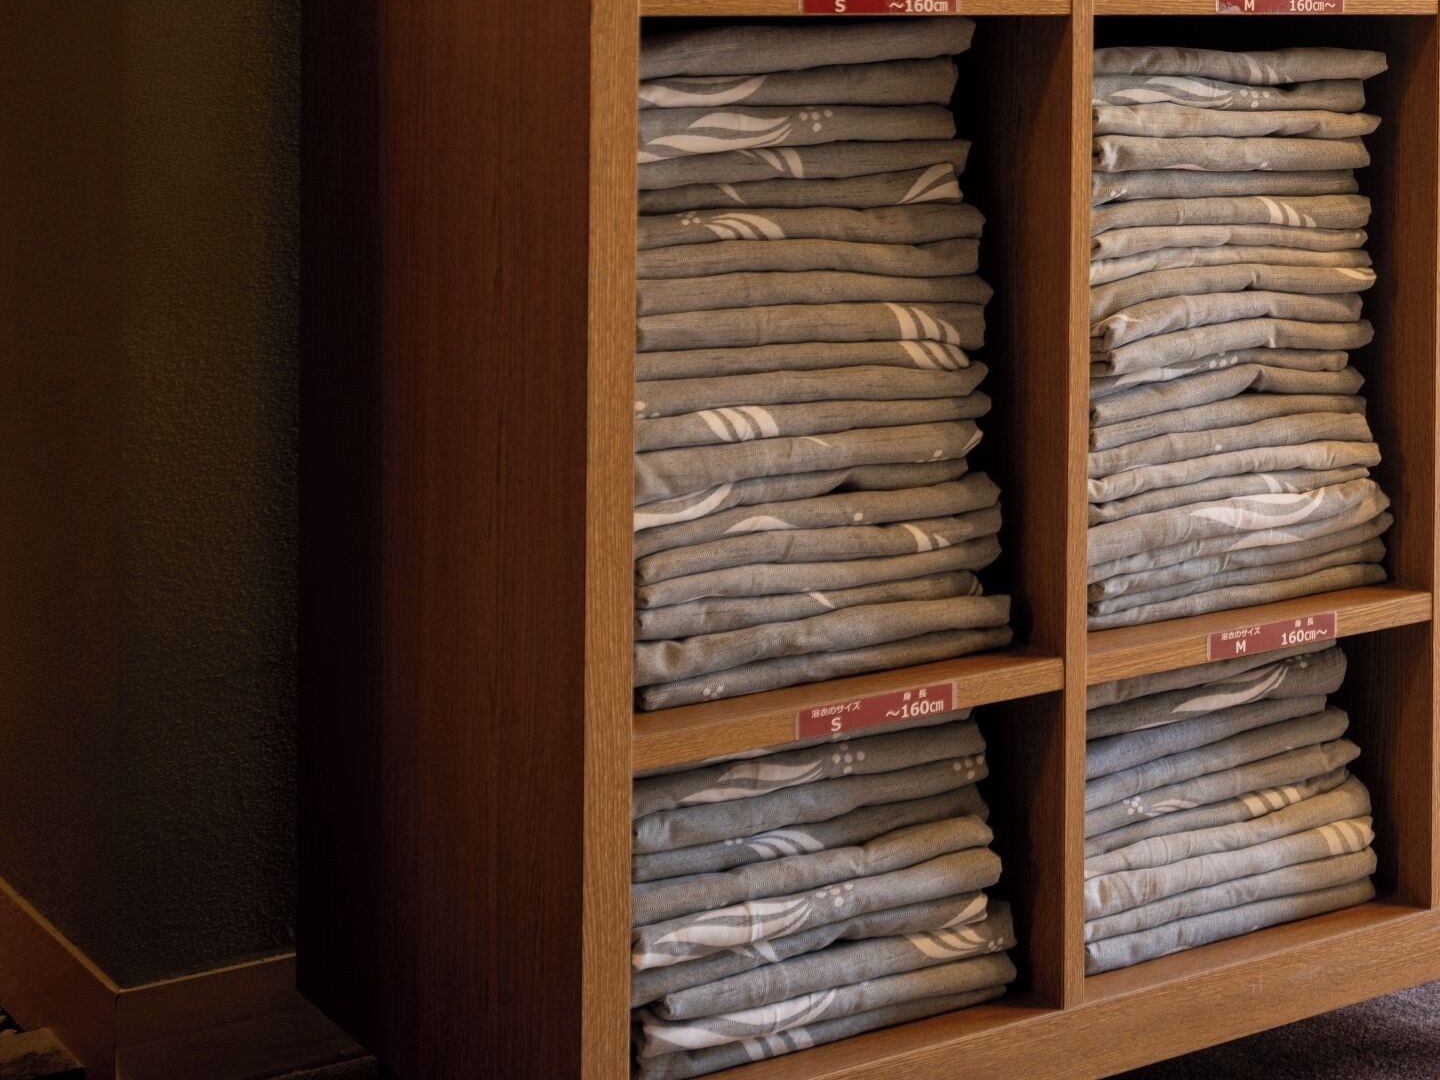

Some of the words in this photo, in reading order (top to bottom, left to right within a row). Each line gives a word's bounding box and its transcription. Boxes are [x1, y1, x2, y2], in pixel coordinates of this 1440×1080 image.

[1244, 0, 1255, 12] M
[1235, 640, 1246, 654] M
[831, 717, 842, 732] S
